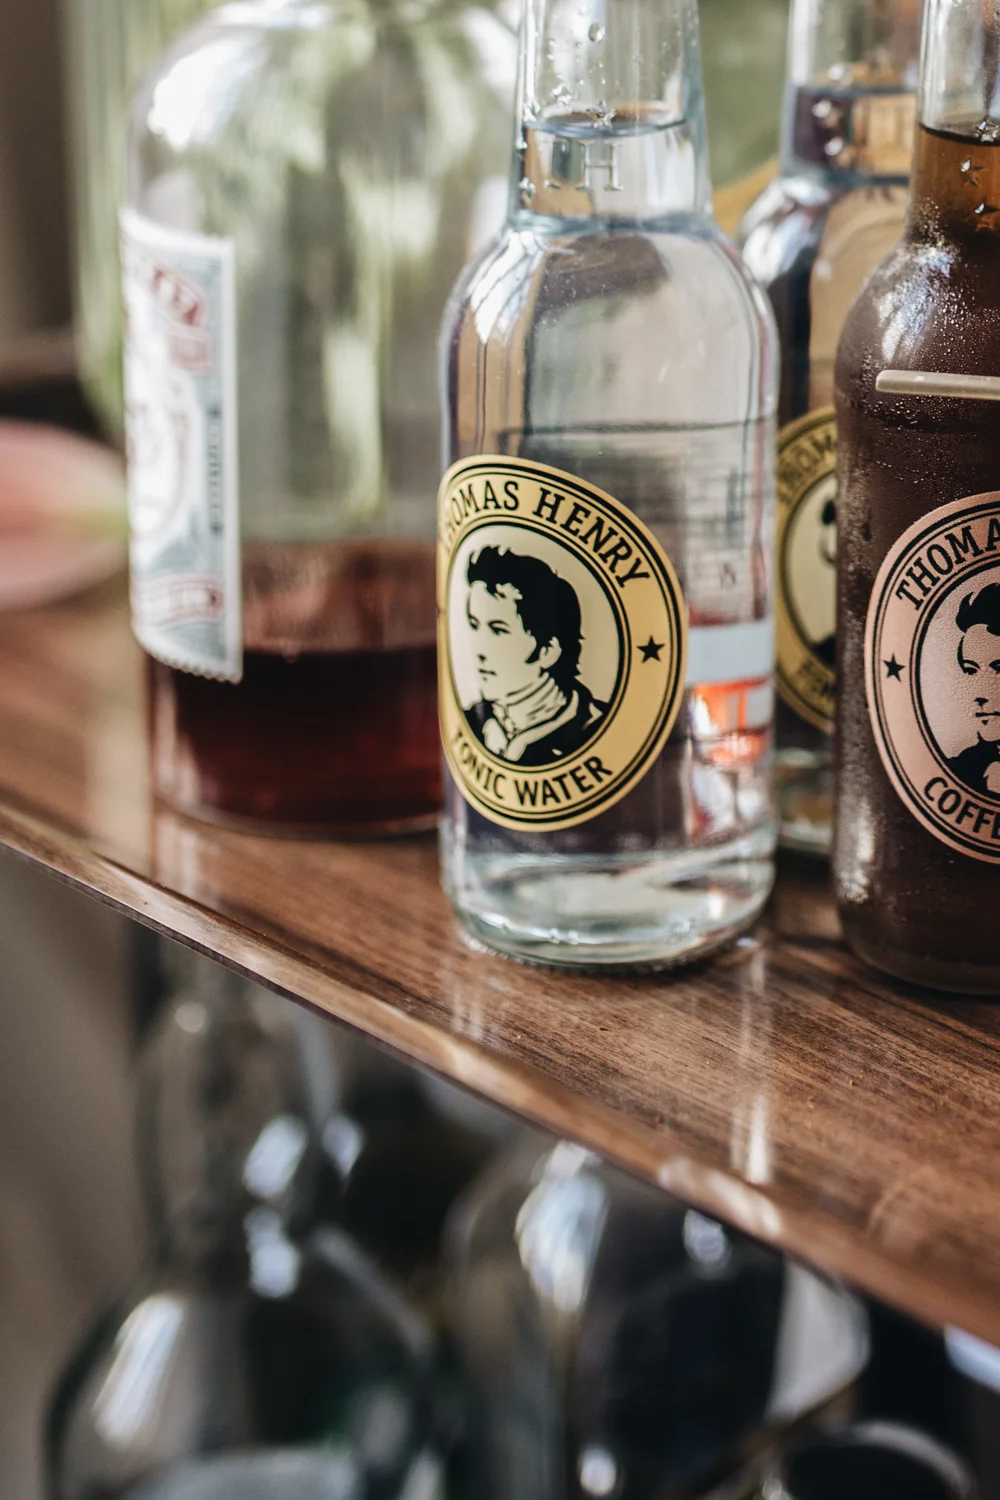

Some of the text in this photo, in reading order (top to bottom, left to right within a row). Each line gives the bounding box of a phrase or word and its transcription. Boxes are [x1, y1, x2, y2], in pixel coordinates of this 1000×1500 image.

[532, 487, 650, 588] HENRY
[451, 730, 613, 807] TONIC WATER
